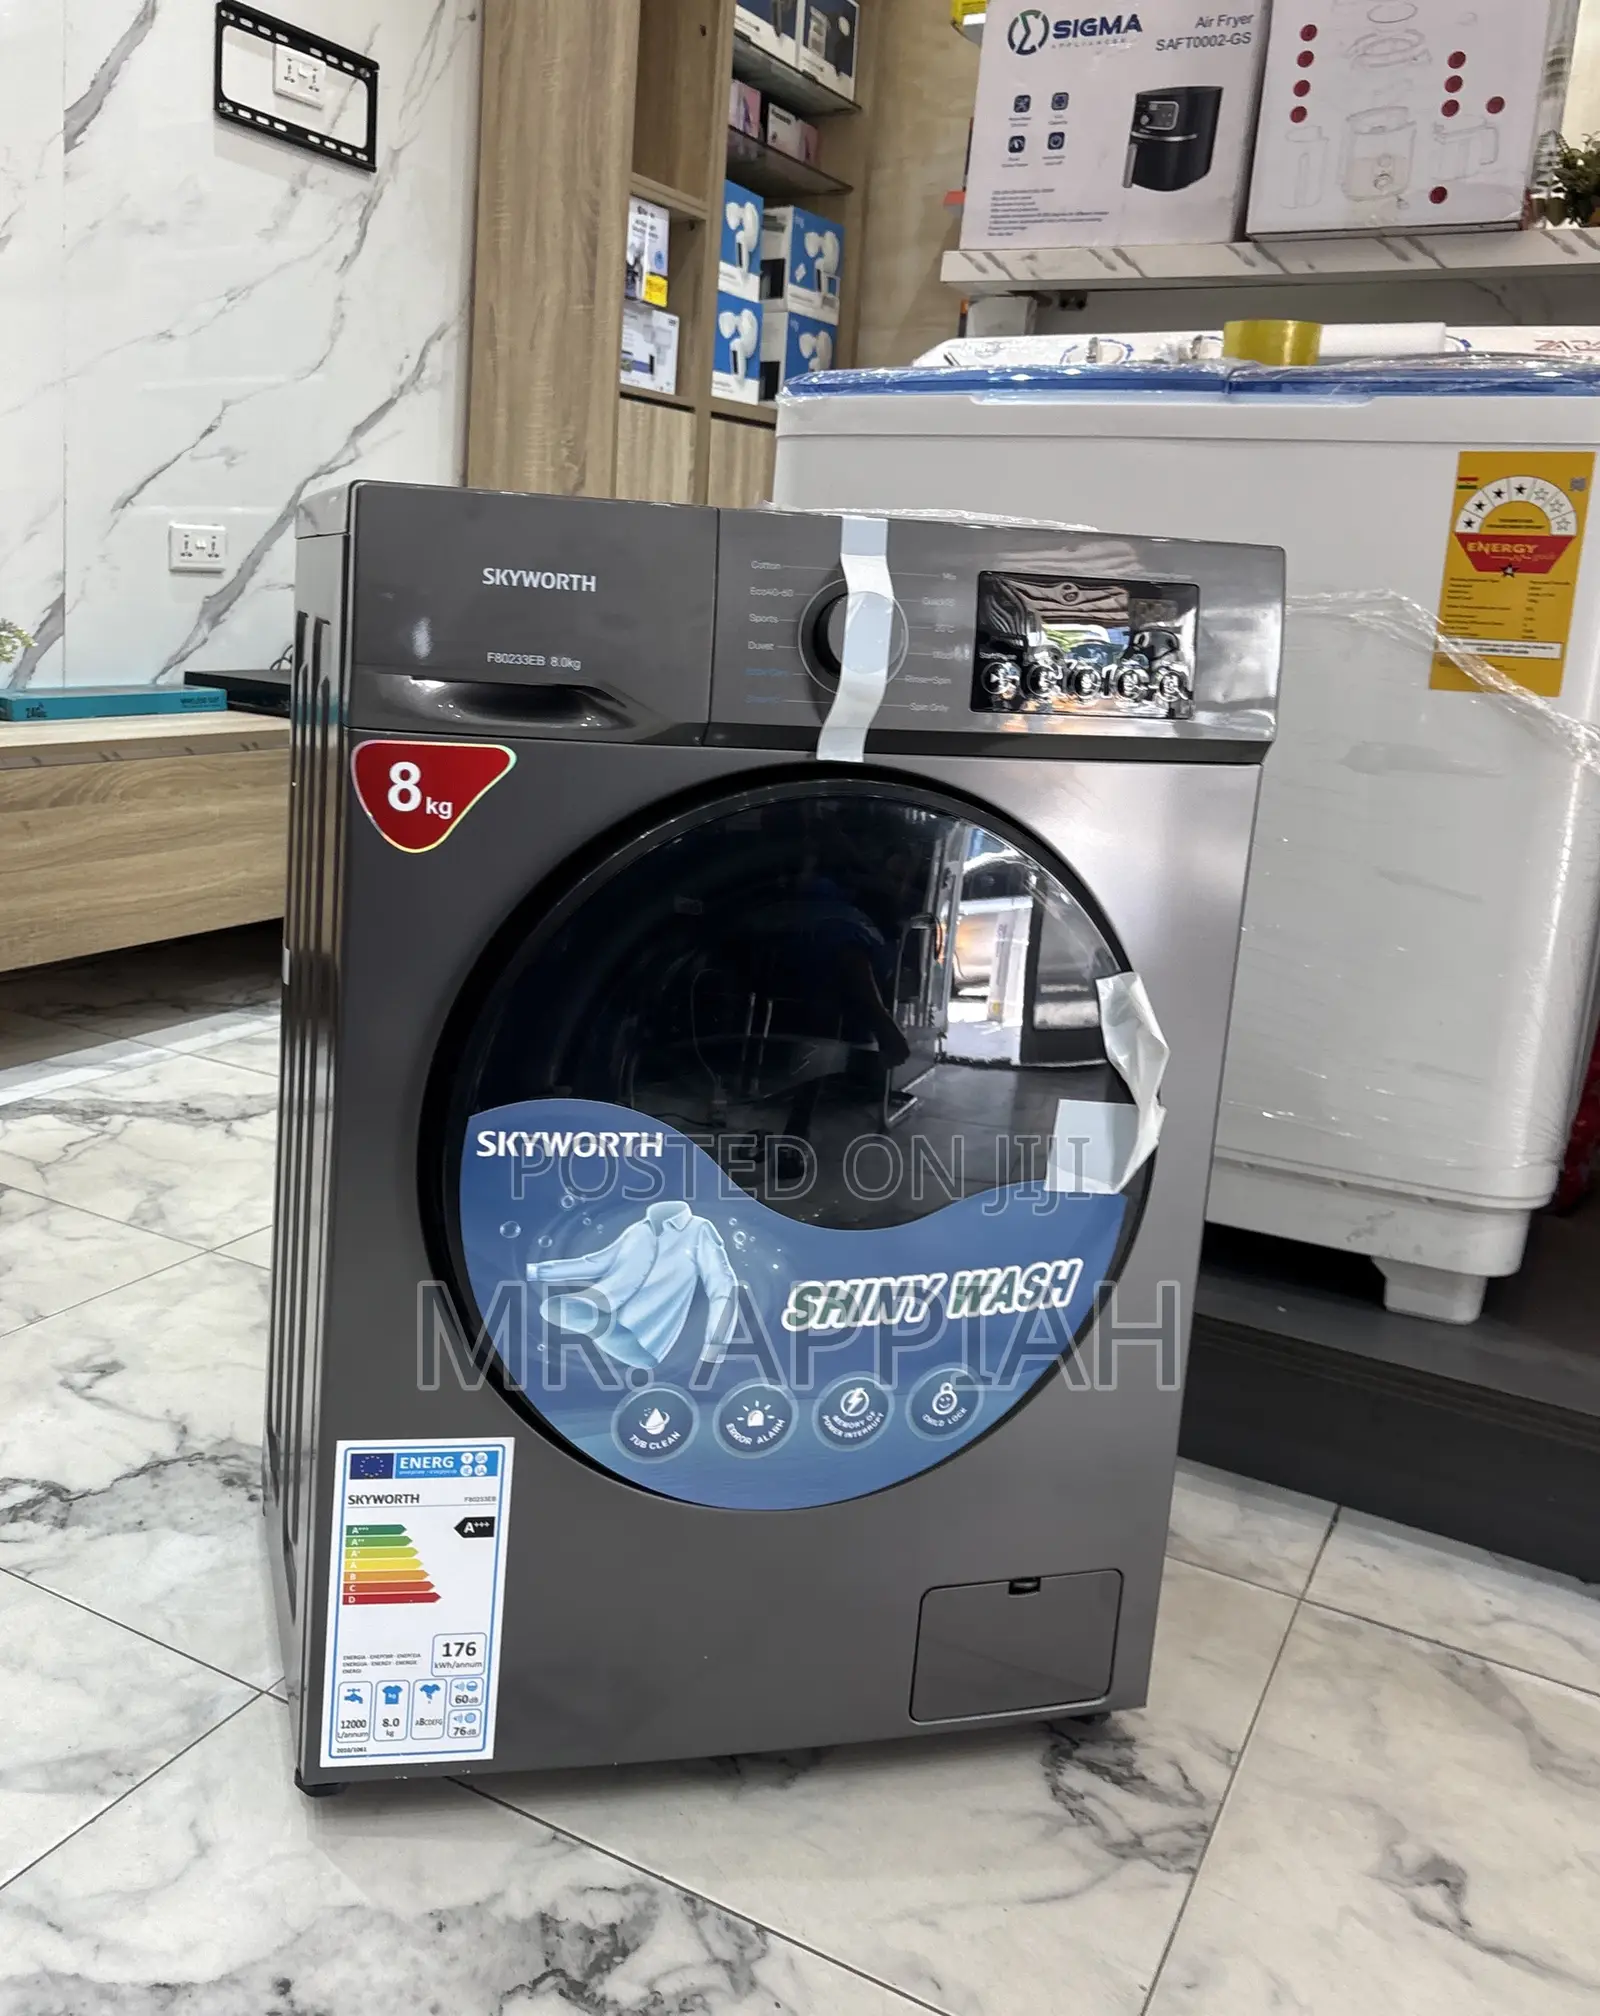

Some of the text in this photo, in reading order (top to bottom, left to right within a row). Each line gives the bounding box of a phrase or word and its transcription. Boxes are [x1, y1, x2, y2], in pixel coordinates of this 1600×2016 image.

[1053, 13, 1143, 40] SIGMA
[1195, 13, 1254, 29] Air Fryer
[1155, 32, 1252, 51] SAFT0002-GS
[1466, 542, 1539, 554] ENERGY
[750, 560, 782, 570] Cotton
[482, 567, 597, 592] SKYWORTH
[748, 613, 780, 624] Sports
[747, 640, 775, 651] Duvet
[486, 651, 582, 671] F80233EB 8.0kg
[476, 1130, 664, 1158] SKYWORTH
[781, 1258, 1084, 1332] SHINY WASH
[832, 1415, 866, 1429] MEMORY
[922, 1407, 969, 1427] CHILD LOCK
[725, 1419, 786, 1445] ERROR ALARM
[822, 1414, 843, 1438] POWER
[629, 1431, 682, 1450] TUB CLEAN
[400, 1456, 455, 1470] ENERG
[347, 1493, 420, 1505] SKYWORTH
[463, 1521, 491, 1534] A+++
[350, 1561, 357, 1569] A
[349, 1573, 357, 1581] B
[349, 1584, 356, 1592] C
[348, 1596, 356, 1604] D
[441, 1641, 477, 1658] 176
[434, 1661, 483, 1670] kWh/annum
[340, 1719, 367, 1729] 12000
[382, 1717, 400, 1728] 8.0
